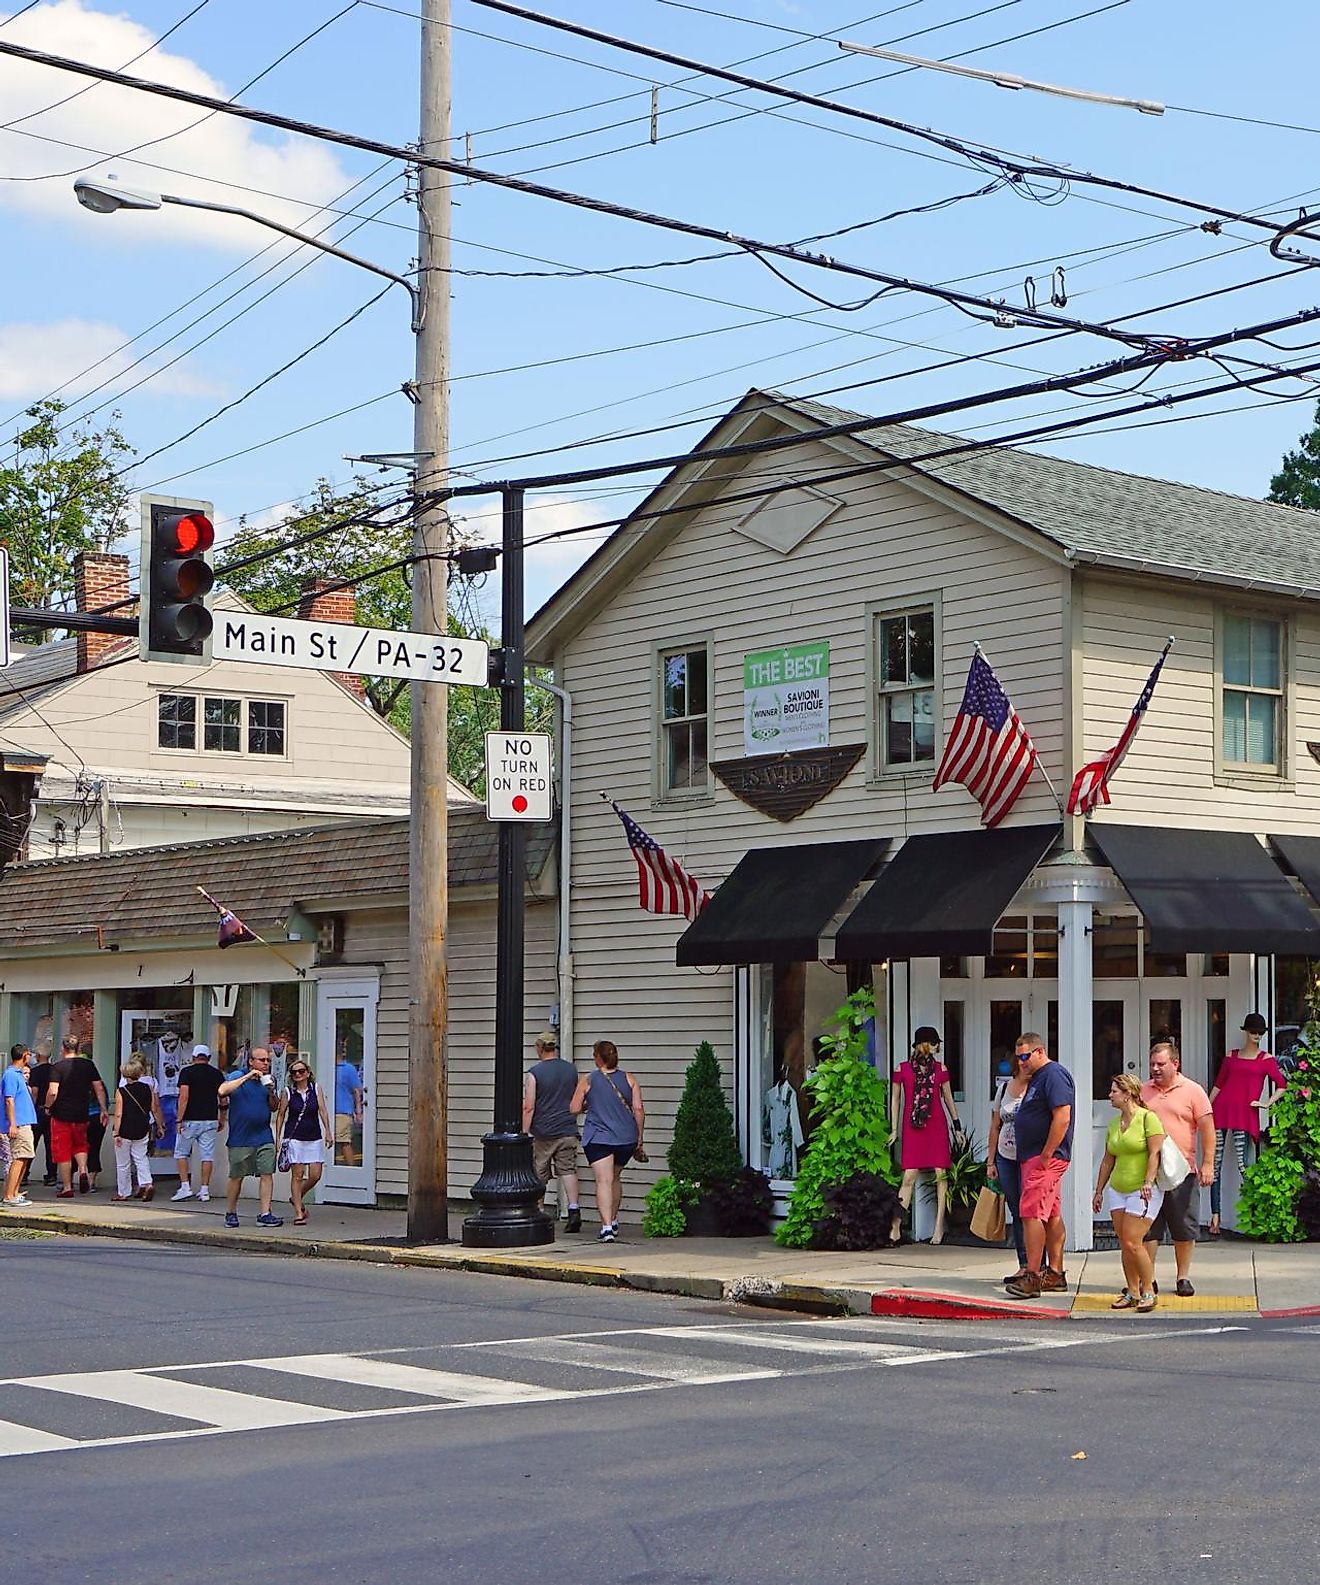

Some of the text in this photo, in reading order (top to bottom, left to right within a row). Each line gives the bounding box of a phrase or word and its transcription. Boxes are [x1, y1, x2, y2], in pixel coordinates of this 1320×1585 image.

[226, 622, 296, 655] Main
[310, 632, 337, 661] St
[377, 640, 463, 674] PA-32
[749, 653, 823, 685] THE BEST
[787, 689, 820, 703] SAVIONI
[754, 707, 778, 718] WINNER
[783, 699, 824, 714] BOUTIQUE
[506, 740, 532, 756] NO
[501, 760, 538, 773] TURN
[750, 763, 825, 785] SAVIONI
[493, 778, 546, 792] ON RED
